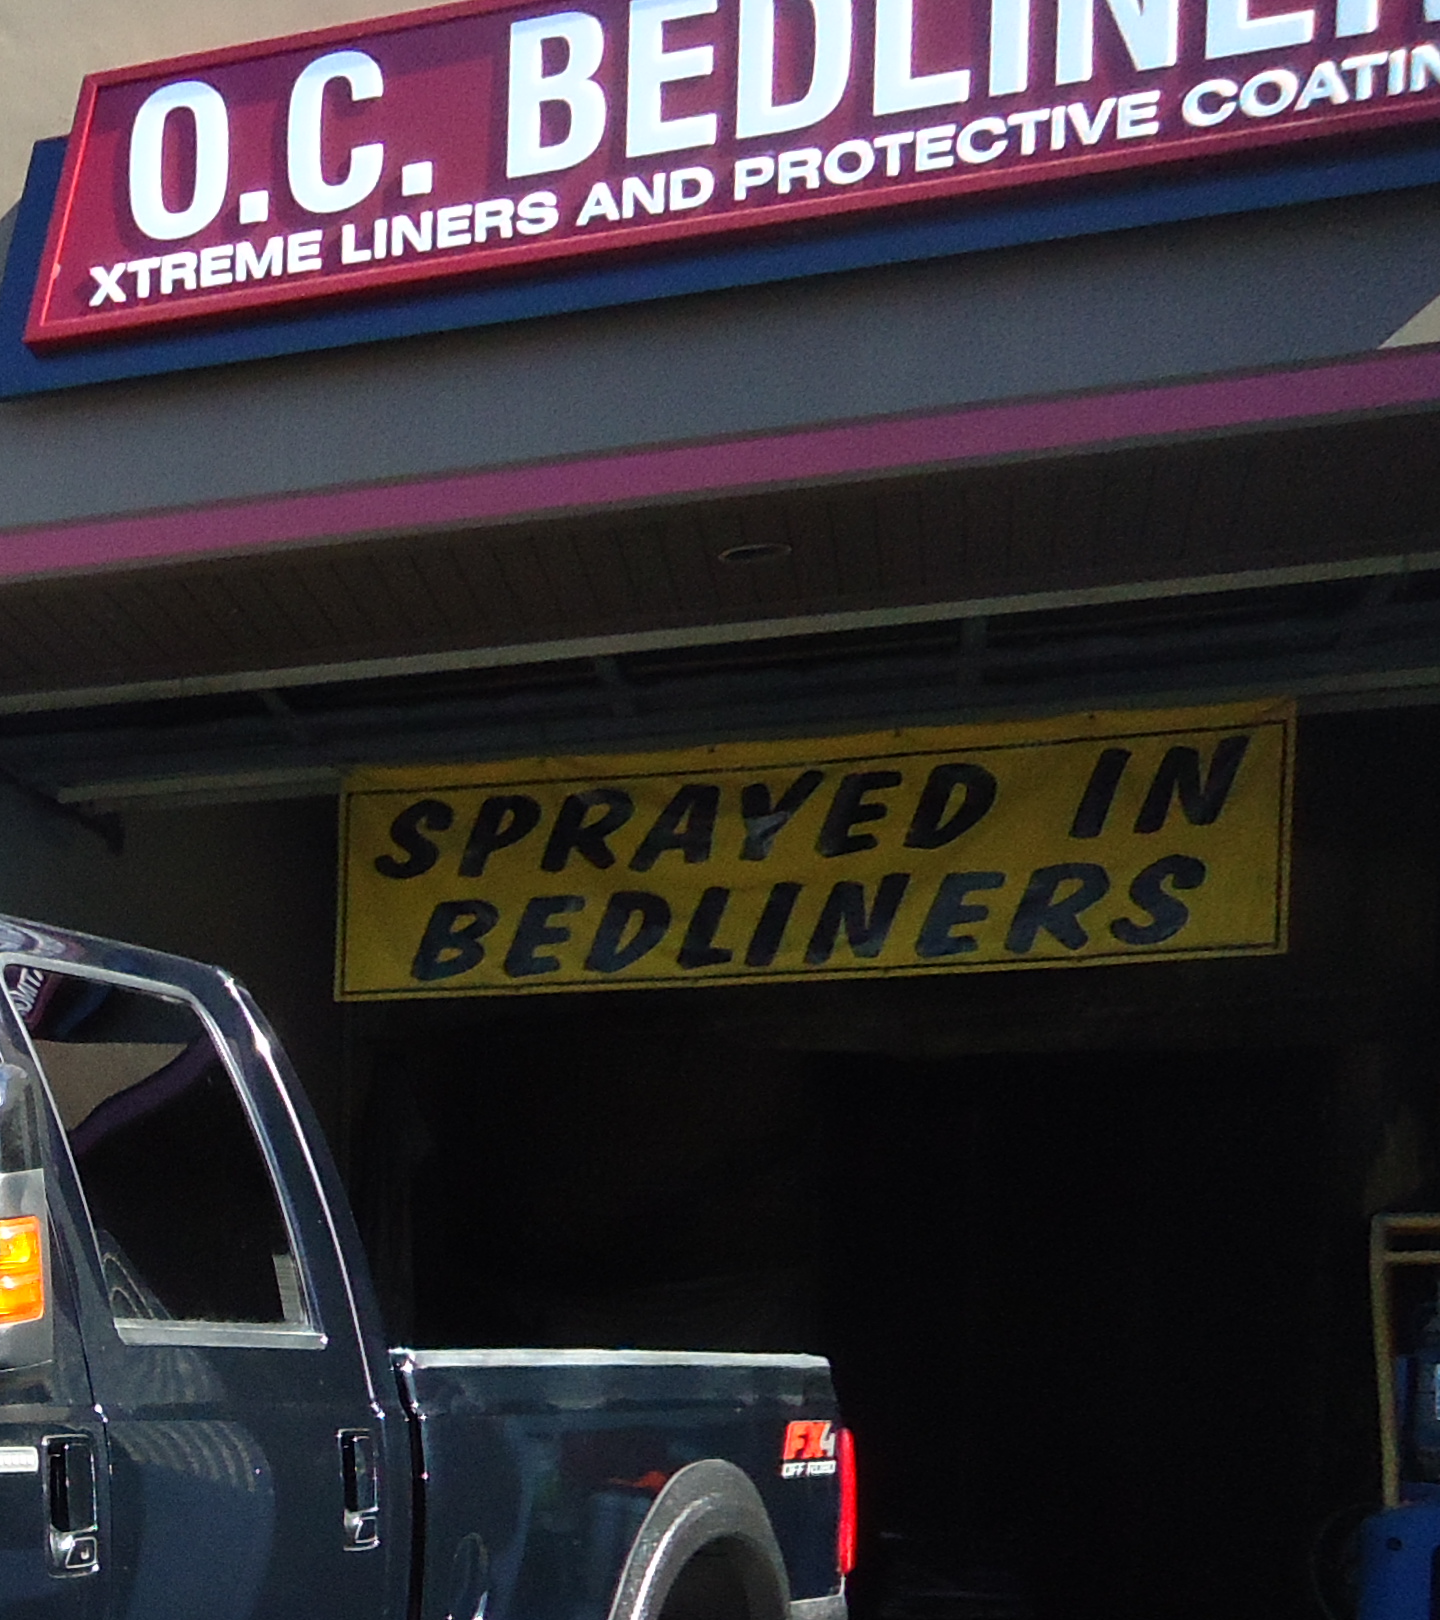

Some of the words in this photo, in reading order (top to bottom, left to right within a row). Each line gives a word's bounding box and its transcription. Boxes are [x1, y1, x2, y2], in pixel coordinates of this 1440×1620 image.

[89, 231, 323, 306] XTREME
[341, 192, 560, 264] LINERS
[576, 168, 714, 226] AND
[733, 89, 1161, 201] PROTECTIVE
[127, 49, 434, 241] O.C.
[374, 762, 999, 880] SPRAYED
[1068, 735, 1252, 839] IN
[409, 852, 1207, 982] BEDLINERS
[784, 1420, 836, 1460] FX4
